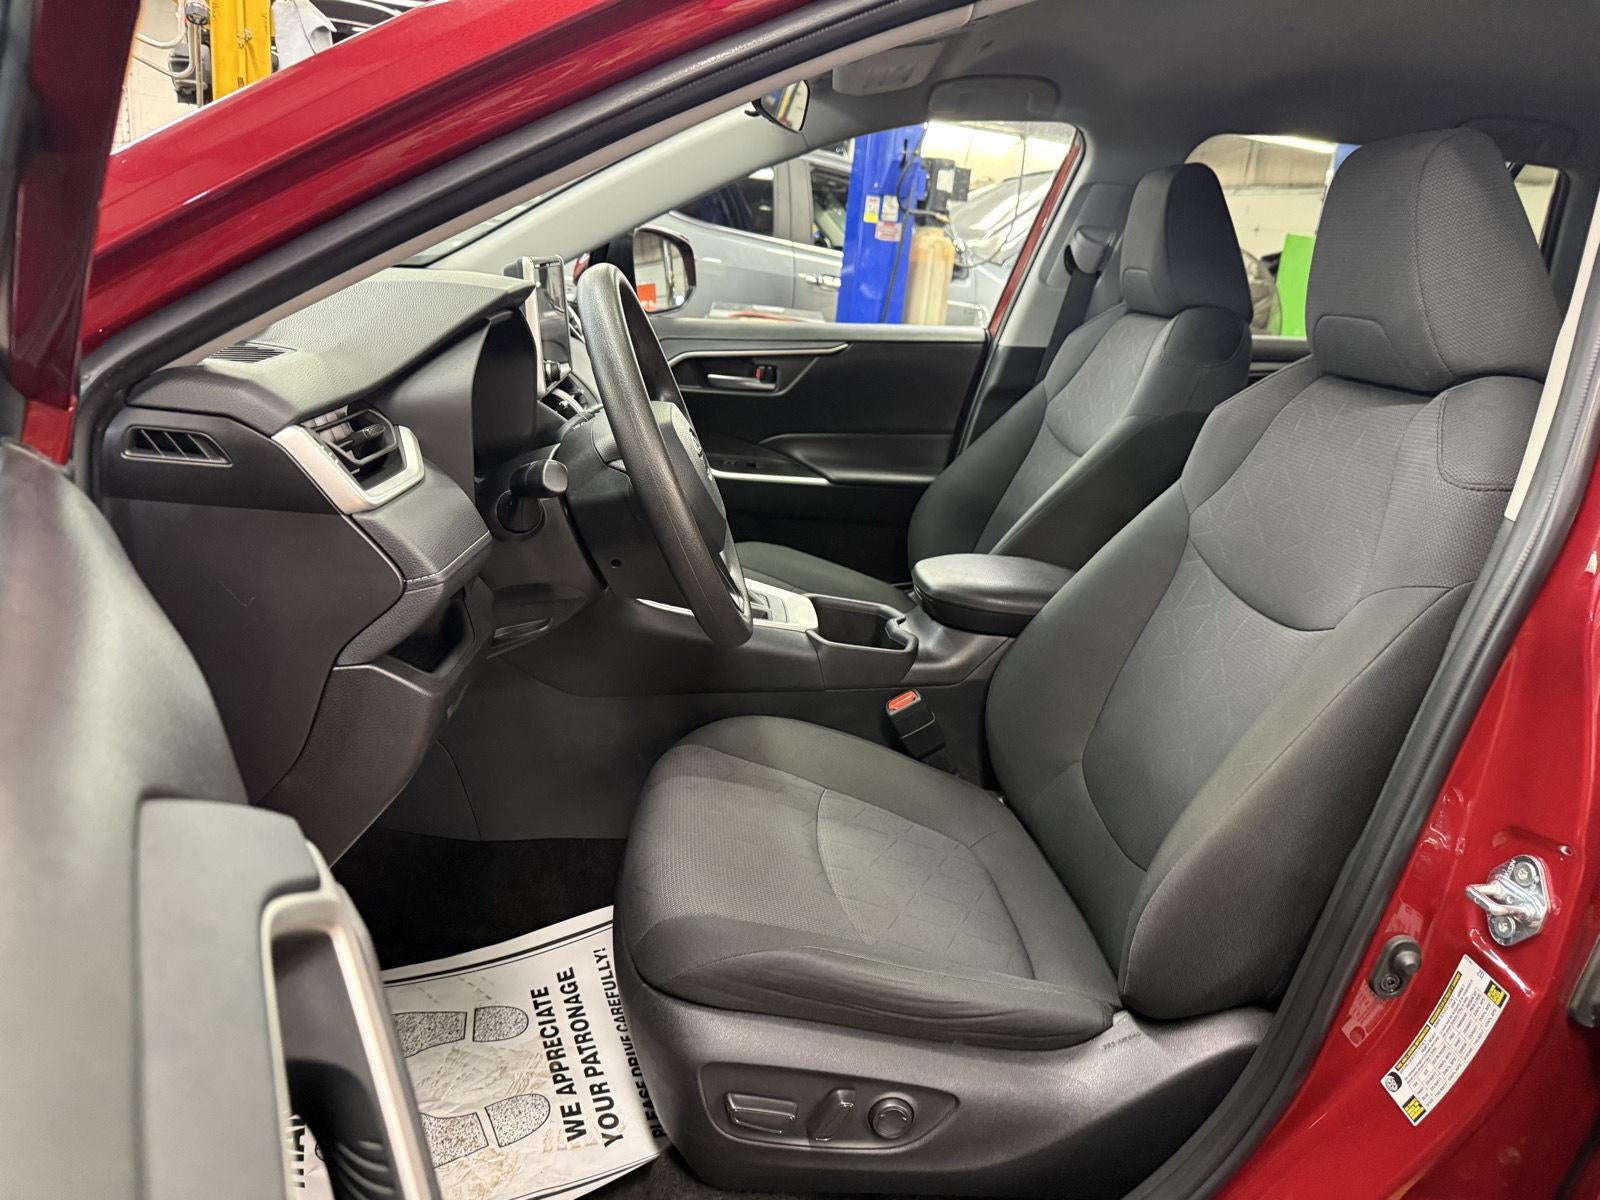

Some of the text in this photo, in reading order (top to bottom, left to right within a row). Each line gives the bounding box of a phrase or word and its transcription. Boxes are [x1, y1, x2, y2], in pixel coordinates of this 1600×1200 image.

[530, 986, 587, 1142] WE APPRECIATE
[556, 966, 624, 1148] YOUR PATRONAGE
[593, 947, 628, 1032] CAREFULLY!
